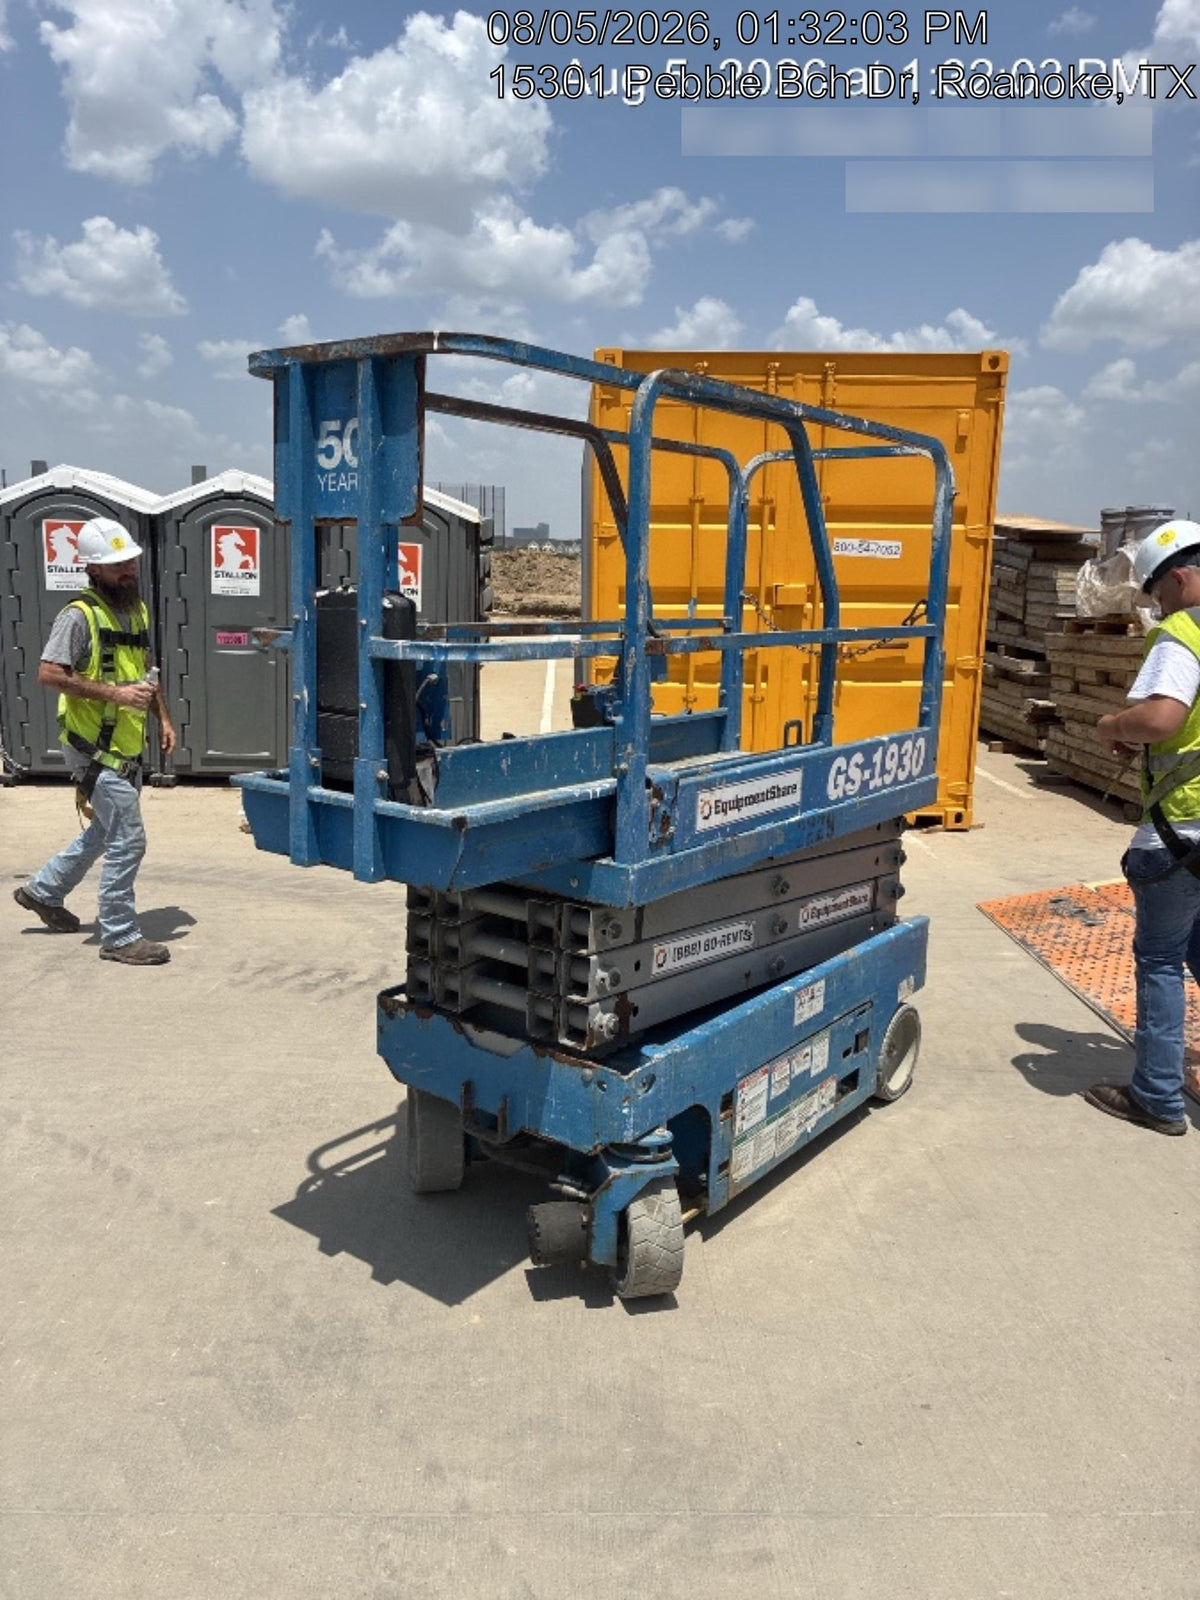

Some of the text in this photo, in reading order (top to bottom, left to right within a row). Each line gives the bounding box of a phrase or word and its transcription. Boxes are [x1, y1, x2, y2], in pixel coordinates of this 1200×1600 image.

[47, 564, 87, 573] STALLIO
[214, 570, 257, 580] STALLION
[826, 736, 926, 801] GS-1930
[714, 782, 798, 816] EquipmentShare
